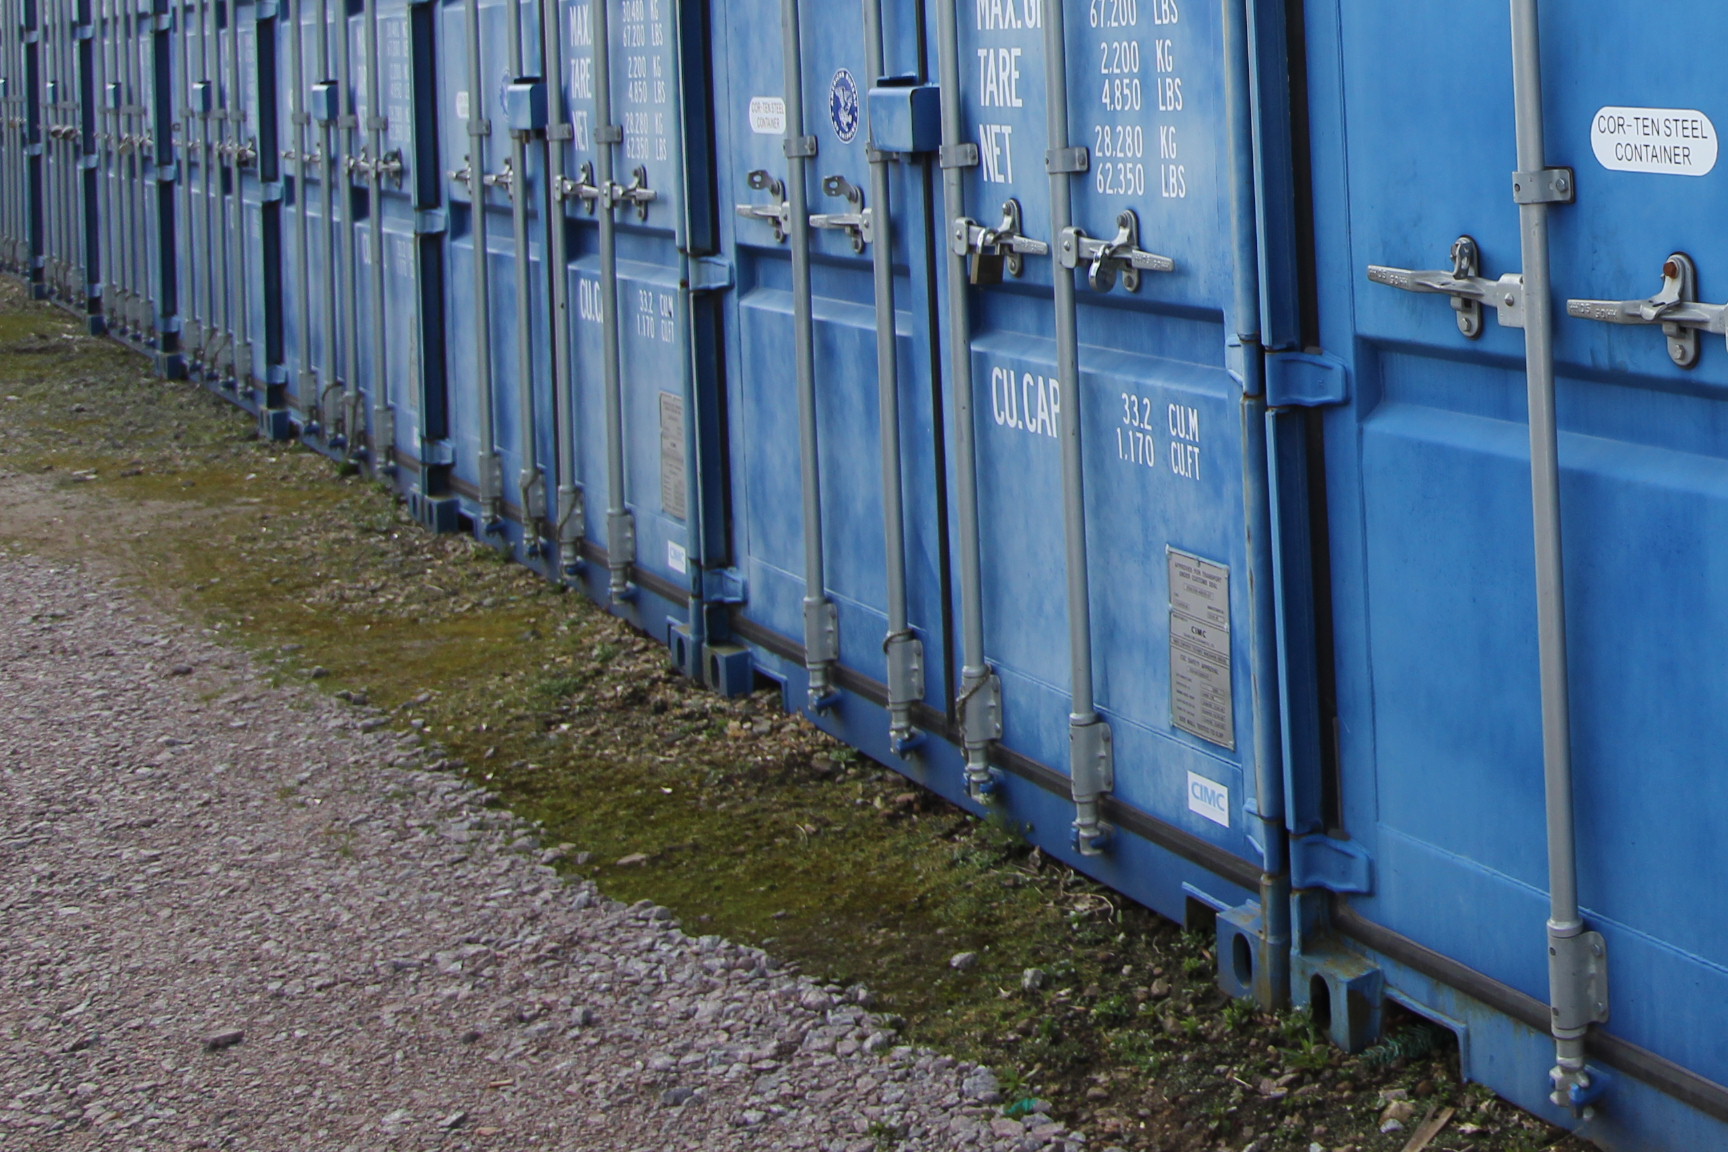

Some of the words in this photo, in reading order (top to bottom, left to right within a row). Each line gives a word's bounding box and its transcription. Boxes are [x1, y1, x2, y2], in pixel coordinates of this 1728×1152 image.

[650, 0, 659, 20] KG
[651, 24, 663, 45] LBS
[652, 56, 662, 77] KG
[1101, 41, 1138, 73] 2,200
[1156, 40, 1172, 72] KG
[571, 58, 591, 98] TARE
[653, 81, 665, 103] LBS
[978, 48, 1022, 107] TARE
[1102, 79, 1140, 110] 4,850
[1158, 78, 1182, 110] LBS
[572, 111, 588, 151] NET
[654, 113, 663, 134] KG
[1597, 114, 1660, 137] COR-TEN
[1663, 118, 1708, 140] STEEL
[655, 138, 666, 160] LBS
[980, 125, 1012, 184] NET
[1096, 126, 1142, 157] 28,280
[1160, 126, 1176, 159] KG
[1615, 142, 1692, 166] CONTAINER
[1097, 163, 1144, 195] 62,350
[1162, 165, 1185, 197] LBS
[1122, 393, 1152, 430] 33.2
[1169, 404, 1198, 442] CU.M
[1171, 442, 1199, 480] CU.FT
[1191, 780, 1225, 812] CIMC
